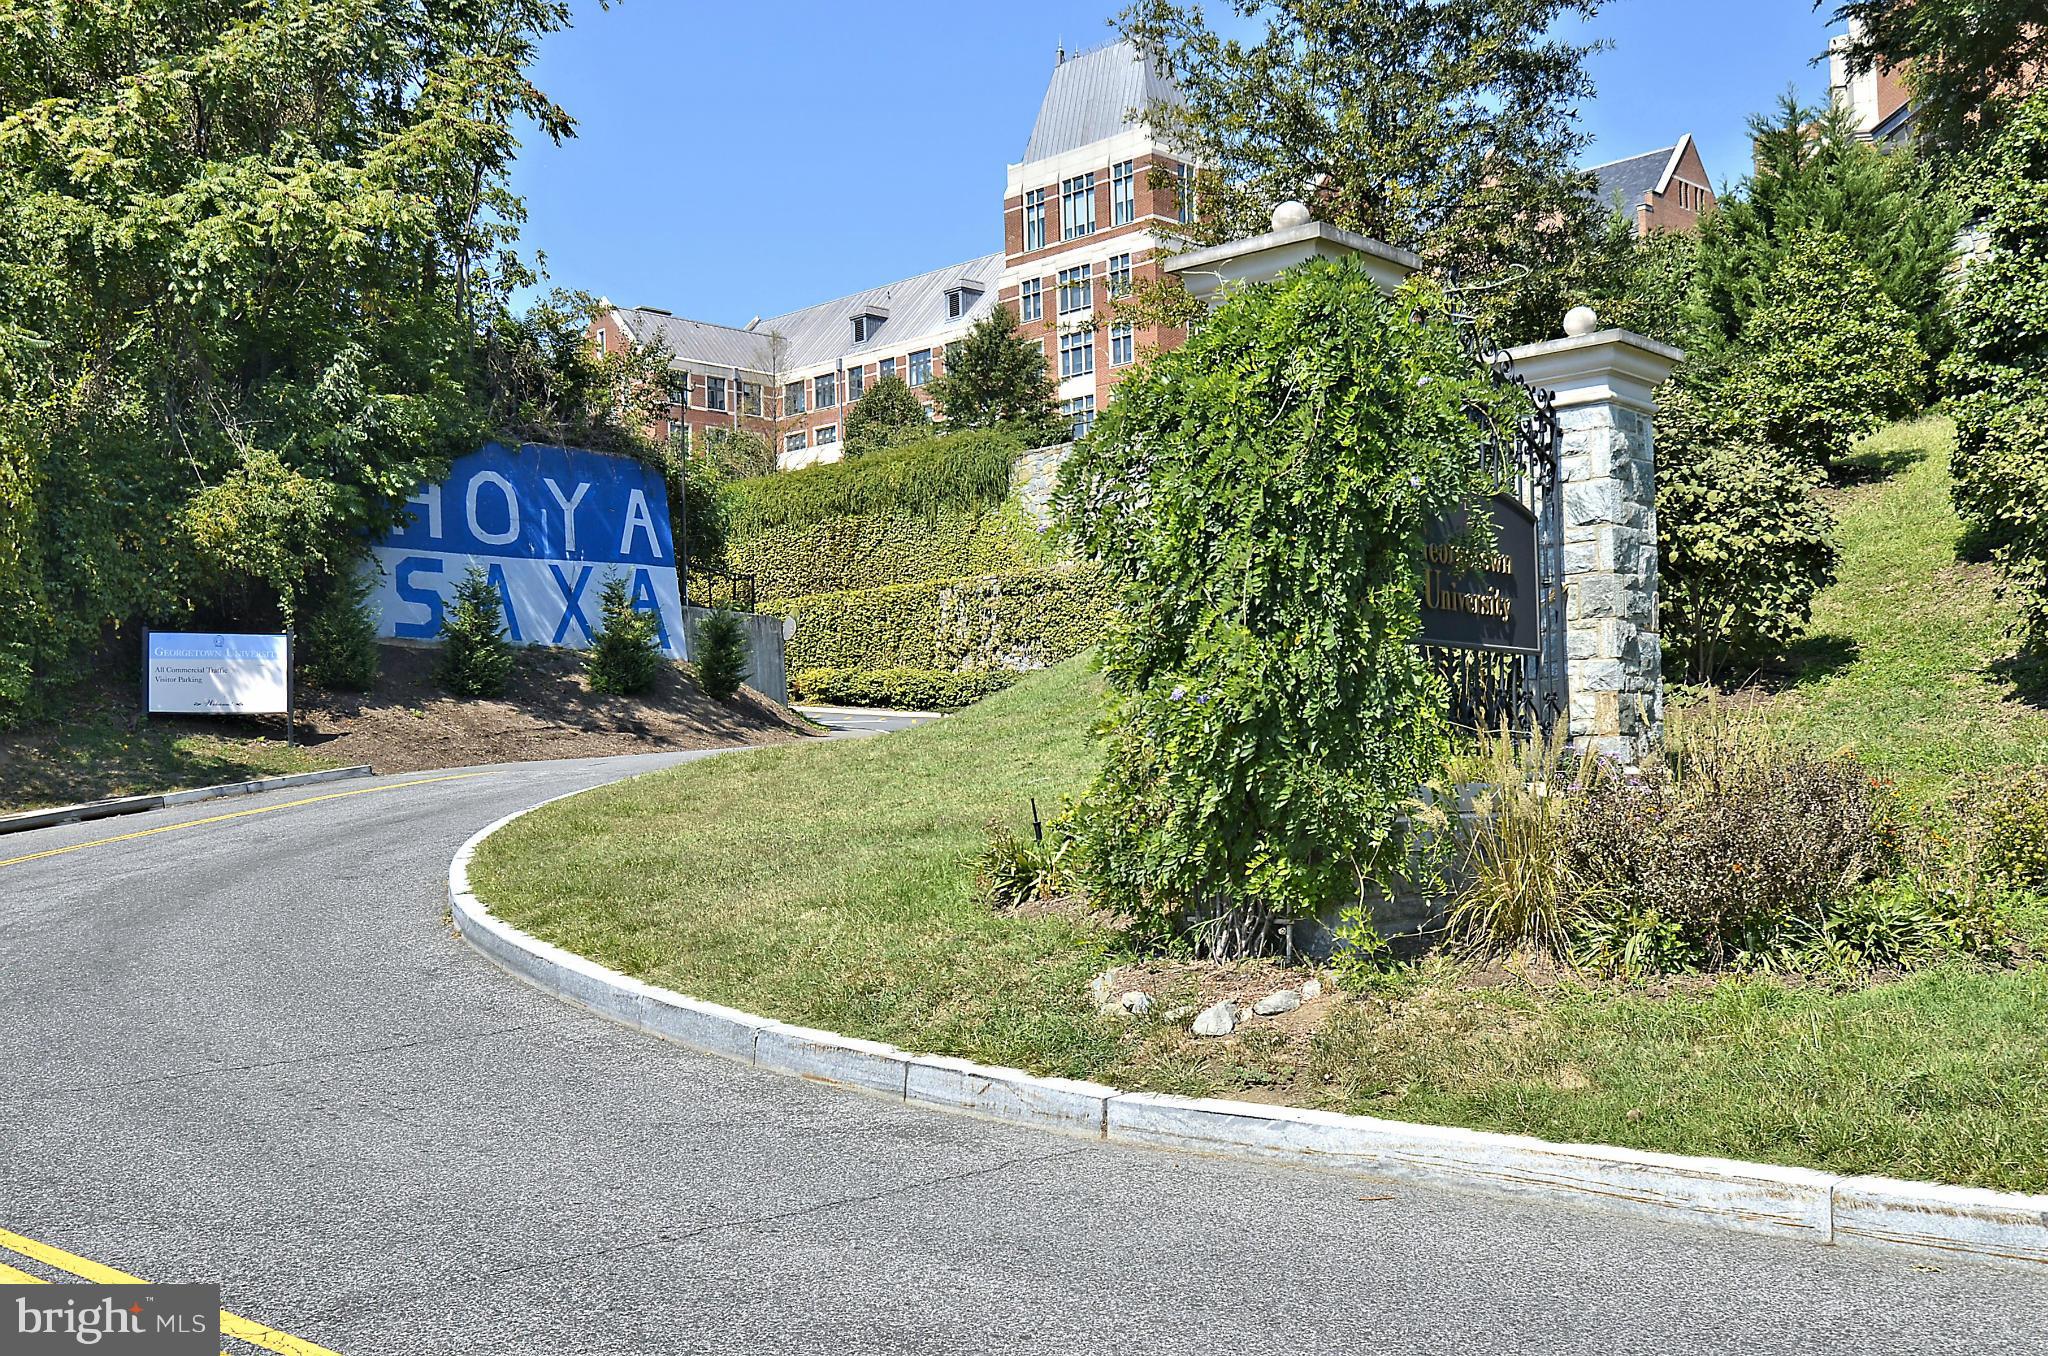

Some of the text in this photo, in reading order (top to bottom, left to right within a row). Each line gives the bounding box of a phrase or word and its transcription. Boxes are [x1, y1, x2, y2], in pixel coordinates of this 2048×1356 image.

[391, 470, 663, 558] HOYA
[1424, 568, 1511, 622] University
[154, 647, 280, 659] GEORGETOWN UNIVERSIT
[178, 676, 203, 685] Parking
